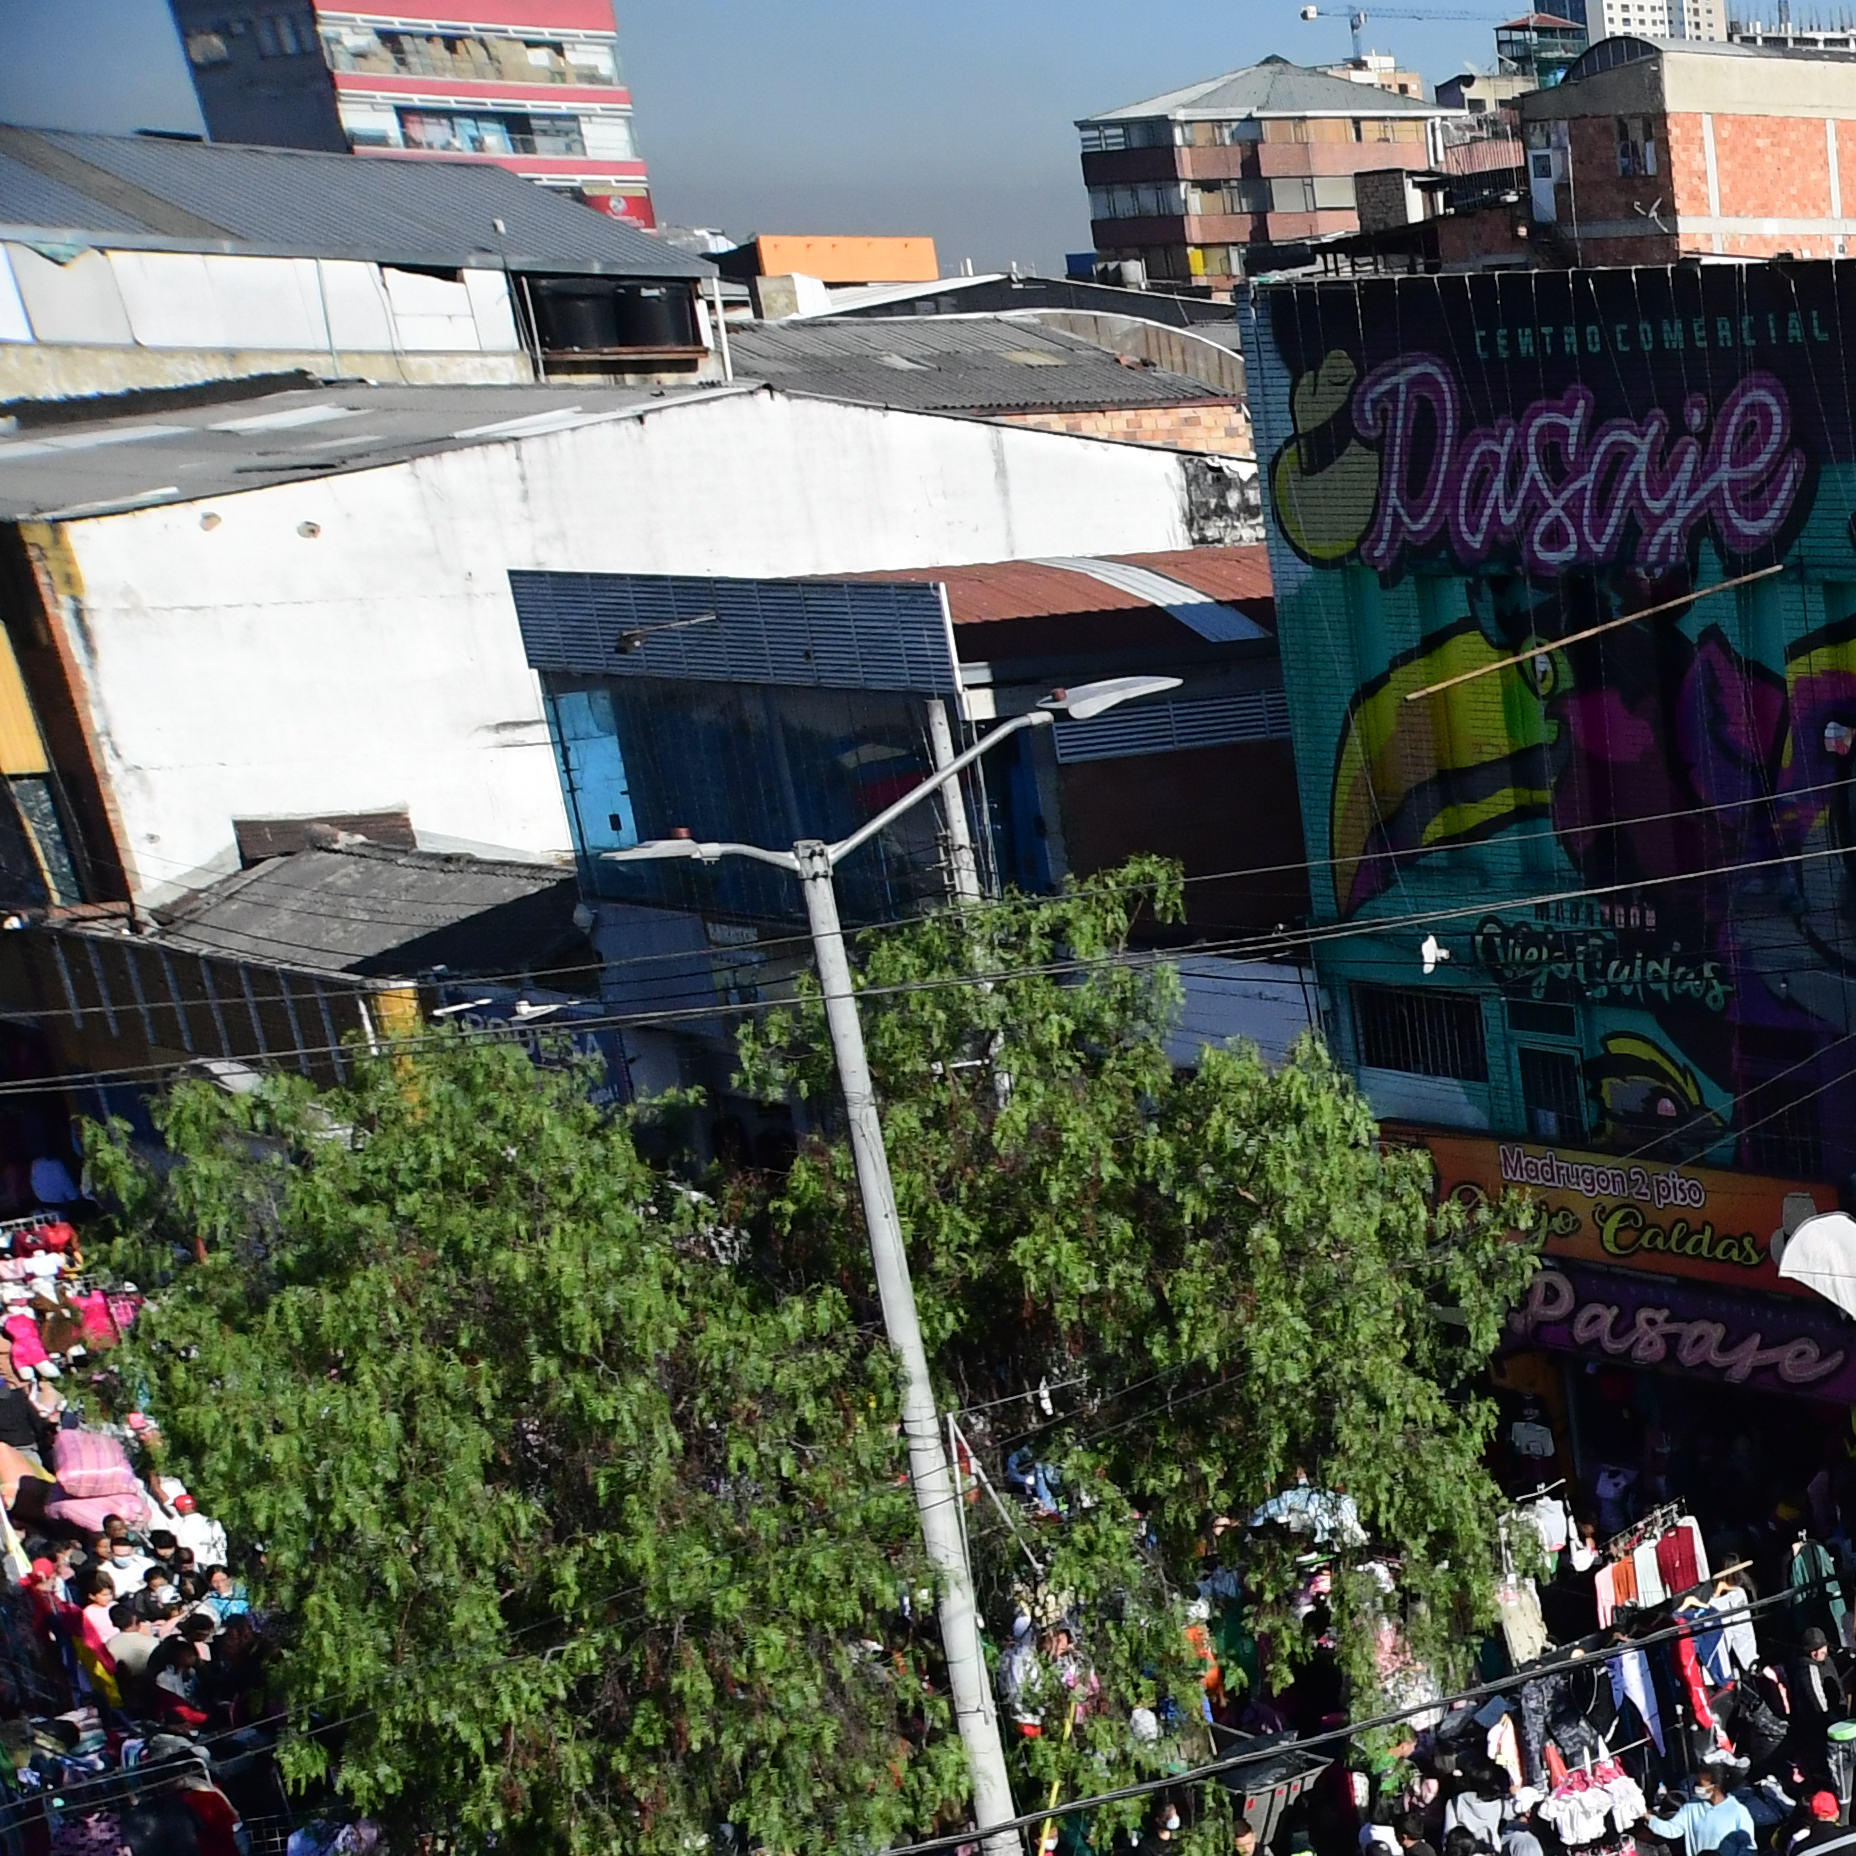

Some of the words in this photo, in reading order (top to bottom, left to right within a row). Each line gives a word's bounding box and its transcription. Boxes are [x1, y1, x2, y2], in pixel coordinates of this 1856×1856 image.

[1474, 324, 1601, 359] CENTRO
[1616, 309, 1830, 352] COMERCIAL
[1352, 352, 1806, 580] Pasaje
[1499, 1143, 1630, 1197] Madrugon
[1628, 1167, 1651, 1202] 2
[1652, 1172, 1706, 1209] piso
[1593, 1201, 1768, 1266] Caldas
